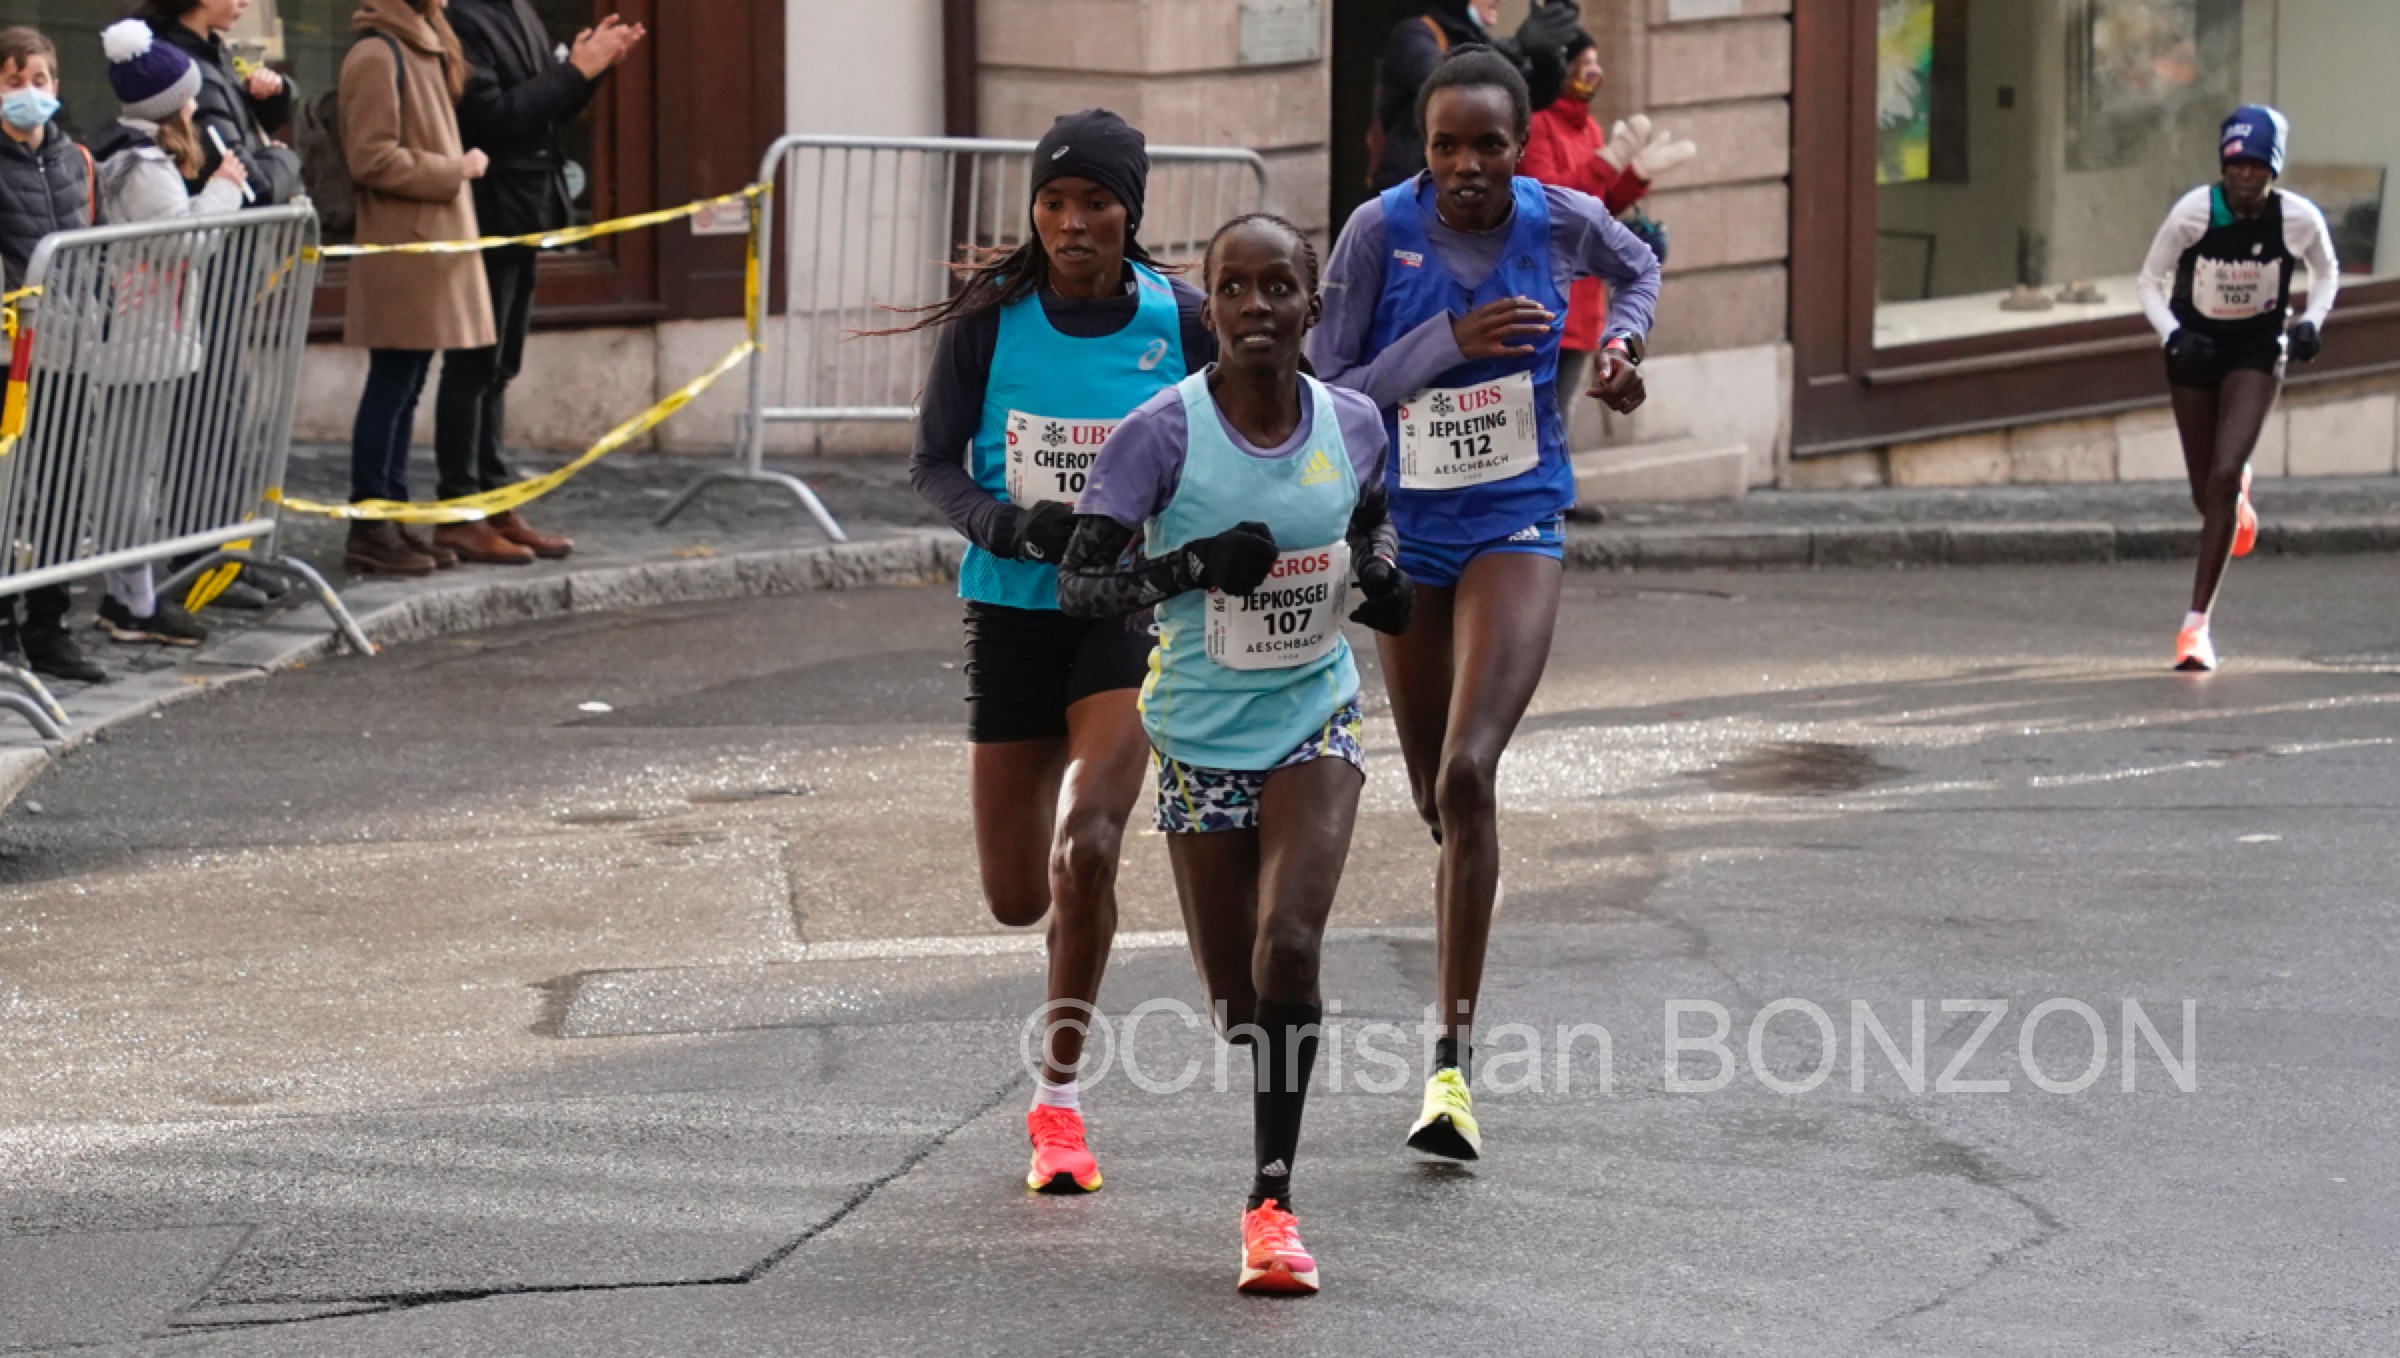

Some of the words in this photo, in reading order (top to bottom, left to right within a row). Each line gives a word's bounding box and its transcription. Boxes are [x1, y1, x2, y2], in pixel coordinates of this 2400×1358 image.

[1457, 385, 1503, 412] UBS
[1072, 425, 1117, 445] UB
[1428, 409, 1507, 438] JEPLETING
[1449, 433, 1492, 459] 112
[1434, 453, 1509, 474] AESCHBACH
[1240, 582, 1329, 612] JEPKOSGEI
[1263, 607, 1313, 636] 107
[1245, 632, 1326, 653] AESCHBACH
